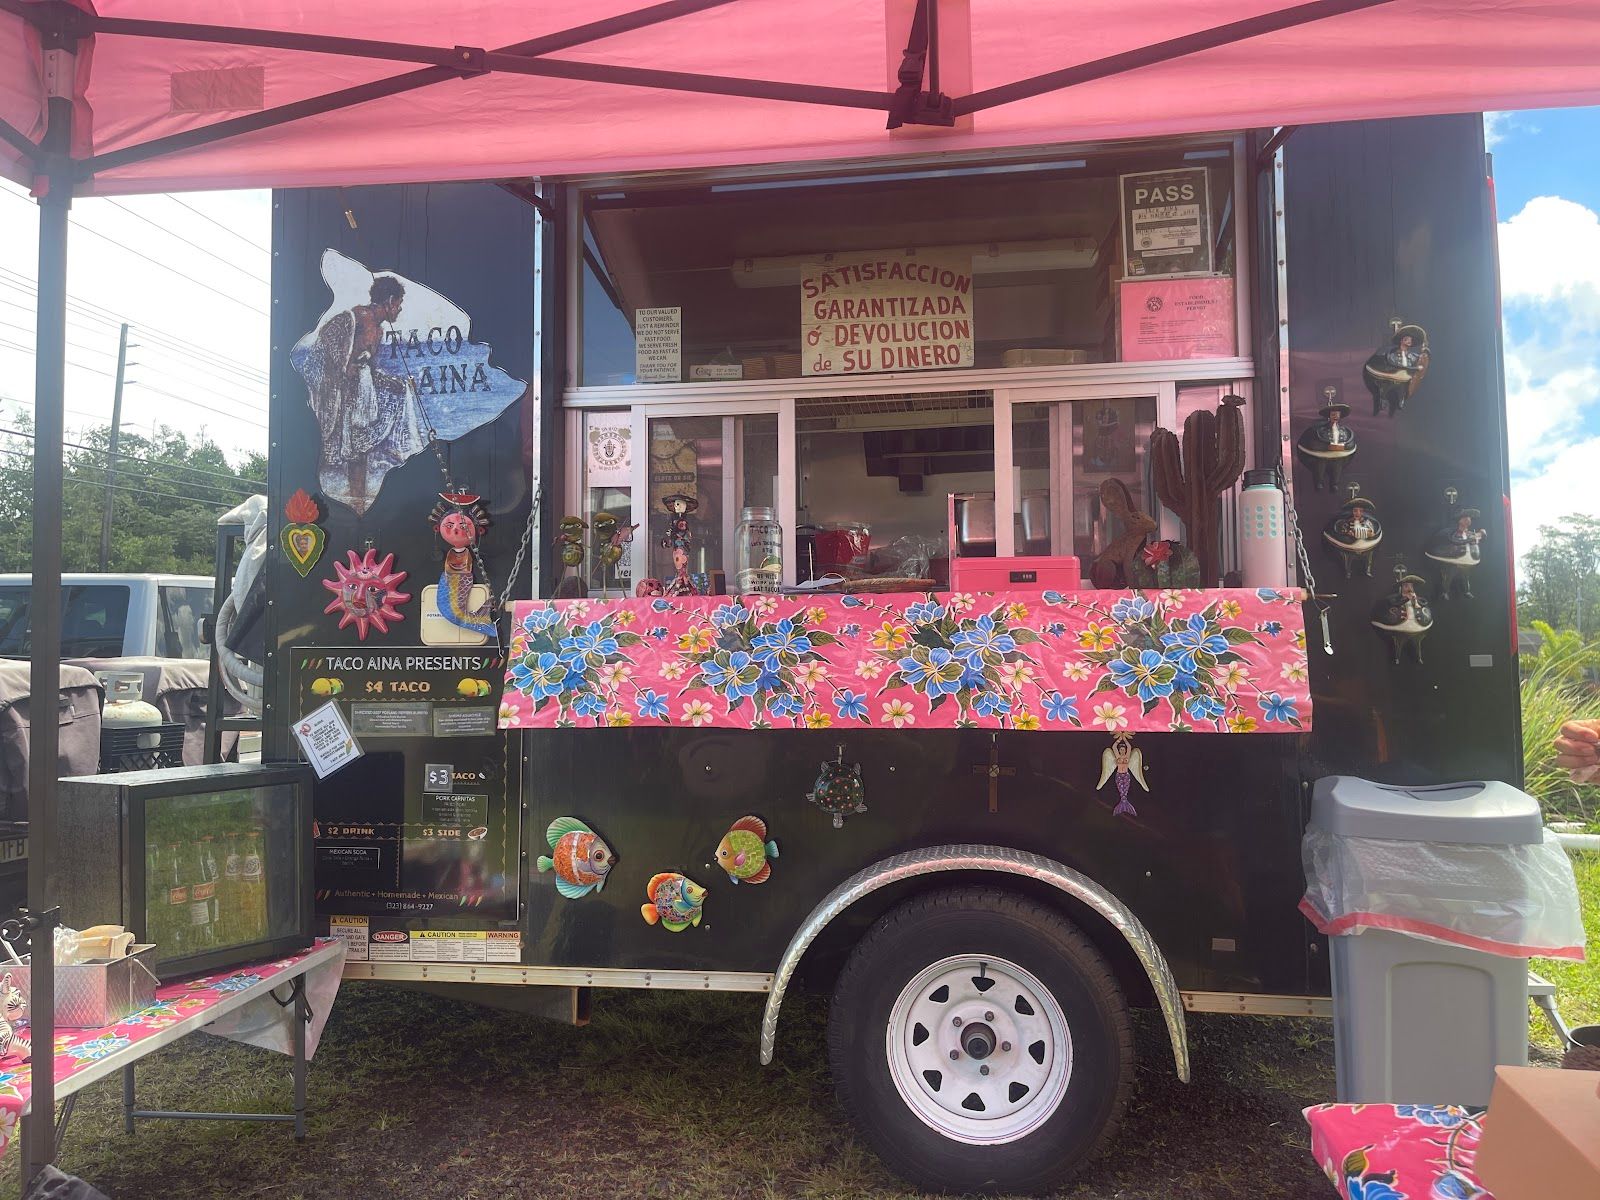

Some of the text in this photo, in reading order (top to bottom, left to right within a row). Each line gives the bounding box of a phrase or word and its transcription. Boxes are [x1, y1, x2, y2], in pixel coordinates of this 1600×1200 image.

[1135, 184, 1194, 205] PASS
[802, 261, 971, 299] SATISFACCION
[814, 296, 967, 320] GARANTIZADA
[385, 325, 463, 359] TACO
[834, 319, 970, 347] DEVOLUCION
[812, 353, 832, 373] de
[842, 348, 872, 372] SU
[880, 343, 961, 370] DINERO
[416, 362, 491, 395] AINA
[325, 656, 482, 671] TACO AINA PRESENTS
[365, 680, 431, 693] $4 TACO
[429, 769, 476, 785] $3 TACO
[327, 826, 375, 835] $2 DRINK
[422, 828, 461, 837] $3 SIDE
[334, 889, 458, 900] Authentic Homemade Mexican
[339, 916, 368, 924] CAUTION
